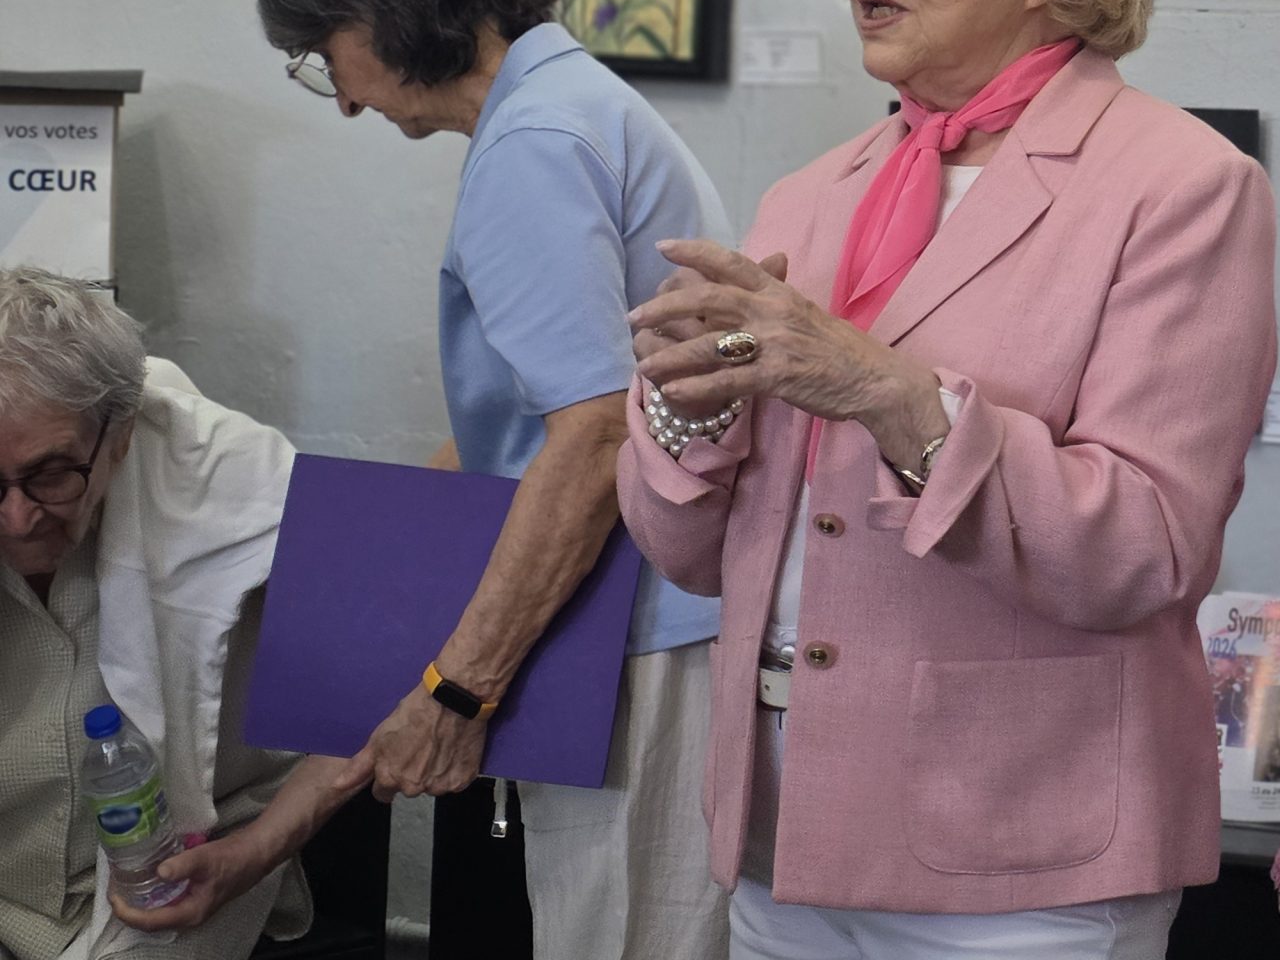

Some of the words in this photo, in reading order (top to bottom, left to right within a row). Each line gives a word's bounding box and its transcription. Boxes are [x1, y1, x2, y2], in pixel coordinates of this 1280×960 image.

[4, 125, 38, 139] vos
[43, 123, 98, 140] votes
[8, 168, 97, 192] CŒUR
